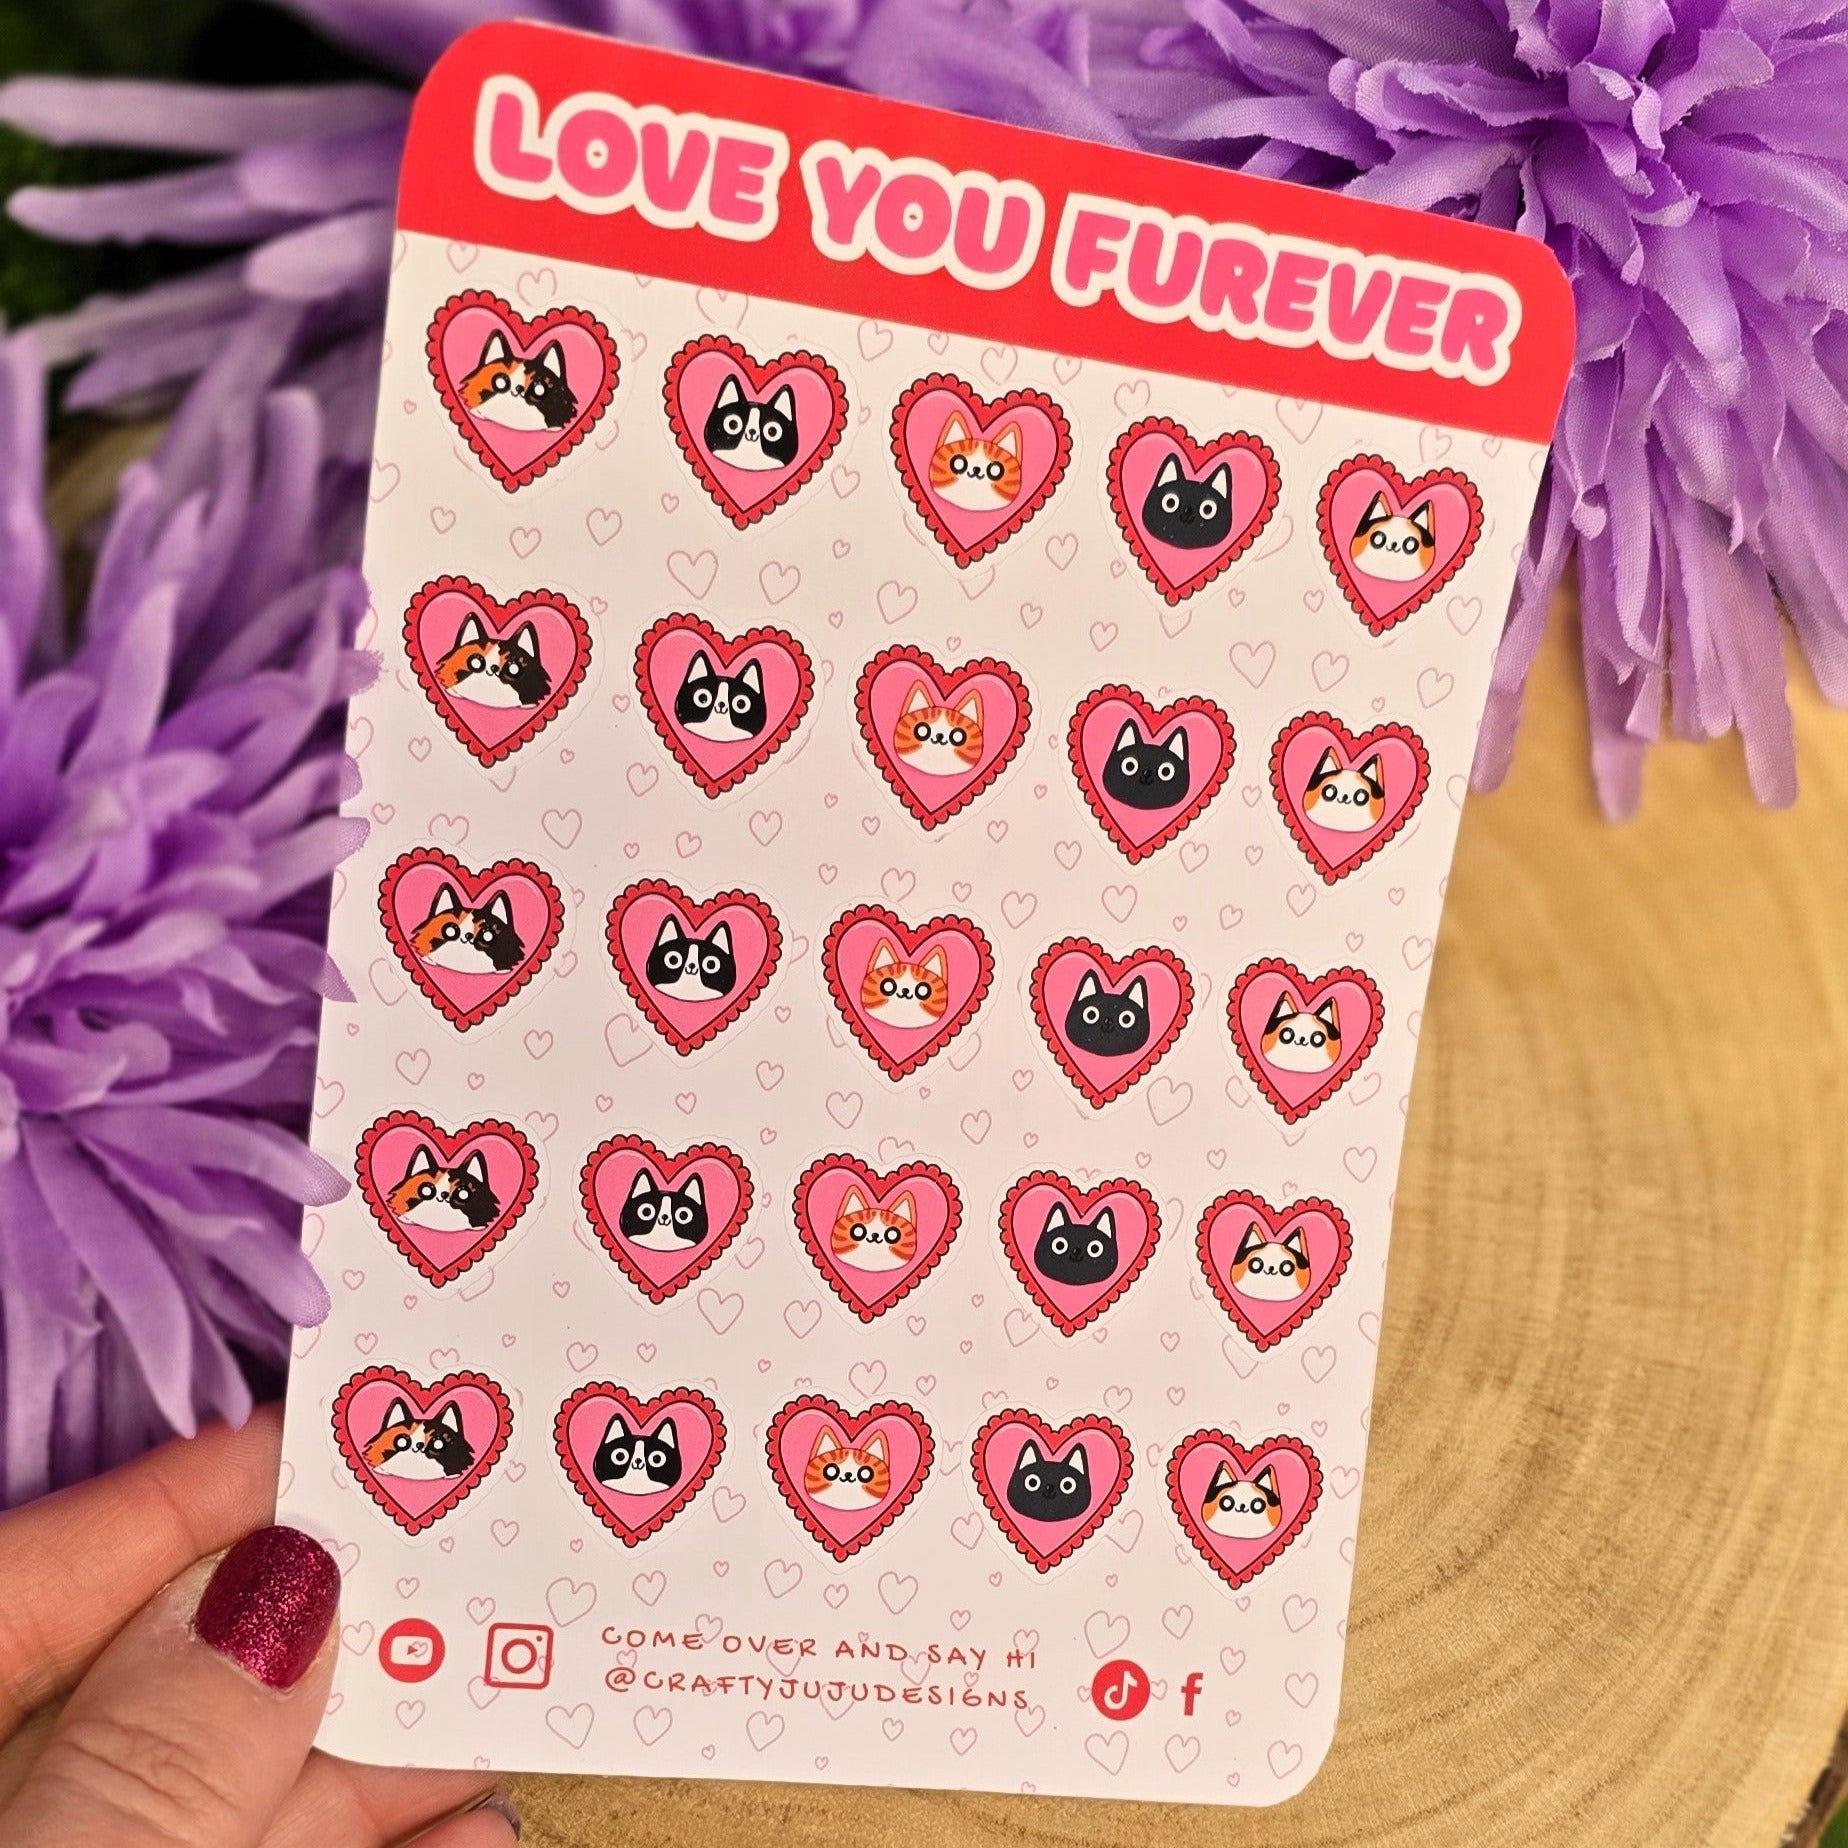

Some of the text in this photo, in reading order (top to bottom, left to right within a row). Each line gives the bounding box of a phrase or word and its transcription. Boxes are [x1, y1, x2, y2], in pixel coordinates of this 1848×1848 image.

[482, 90, 1513, 374] LOVE YOU FUREVER
[601, 1625, 1036, 1671] COME OVER AND SAY HI
[604, 1666, 1029, 1710] @CRAFTYJUJUDESIGNS
[1181, 1672, 1204, 1716] f
